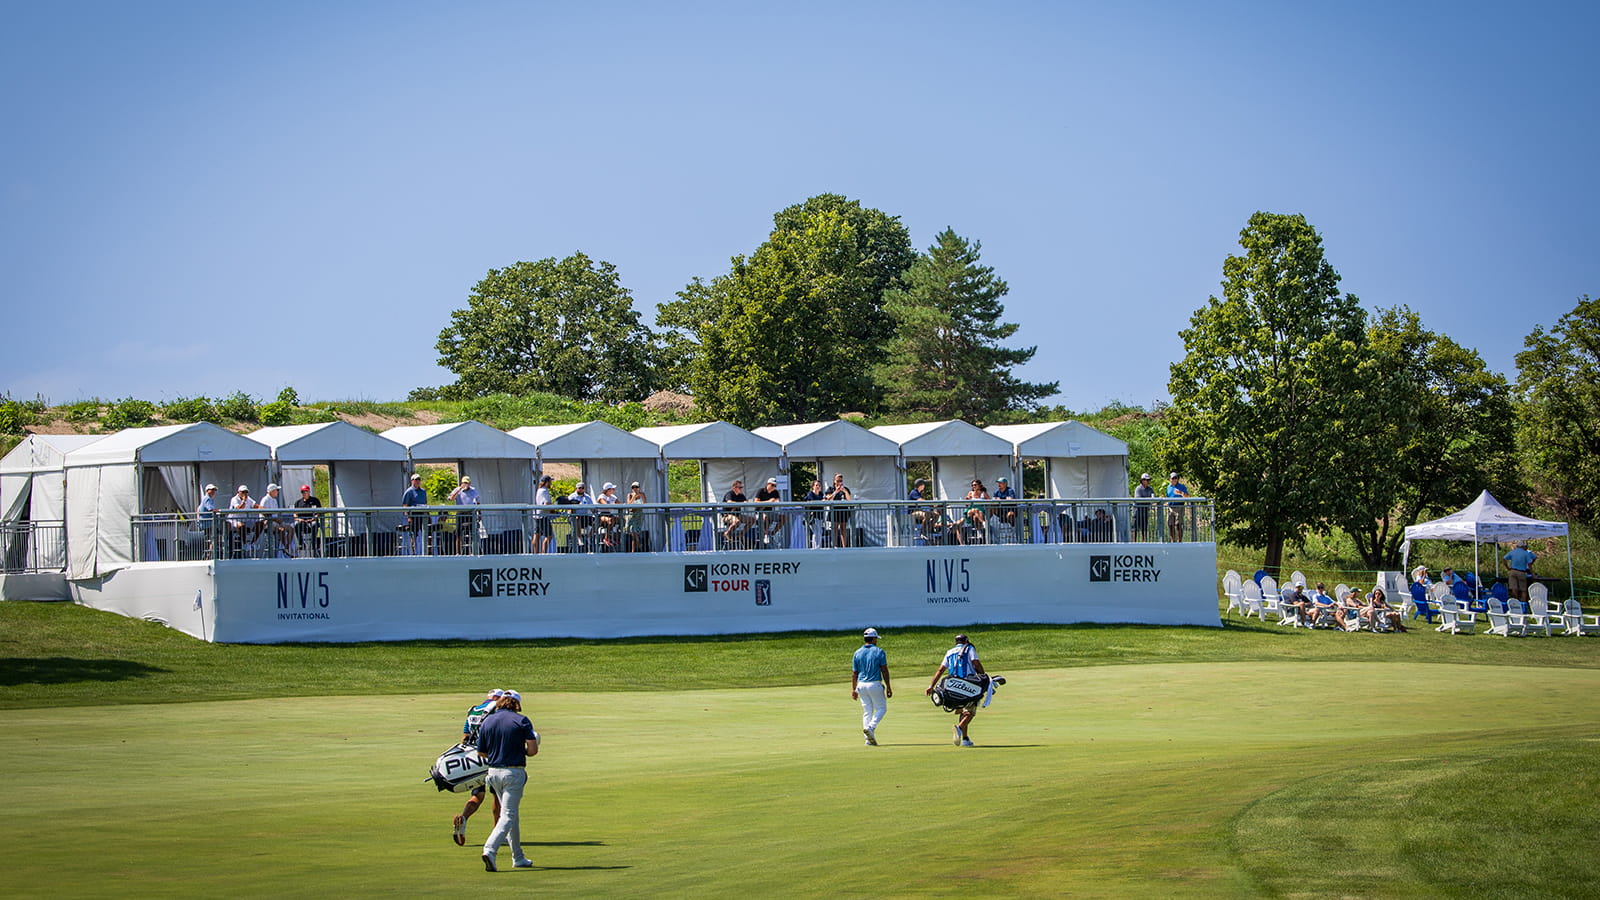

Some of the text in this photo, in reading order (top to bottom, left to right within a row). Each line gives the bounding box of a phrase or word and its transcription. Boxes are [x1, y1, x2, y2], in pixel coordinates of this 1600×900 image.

[1114, 555, 1154, 568] KORN
[496, 567, 543, 581] KORN
[711, 562, 801, 576] KORN FERRY
[1114, 569, 1161, 582] FERRY
[496, 582, 551, 597] FERRY
[711, 579, 750, 592] TOUR
[926, 596, 971, 604] INVITATIONAL
[277, 612, 331, 620] INVITATIONAL
[445, 756, 489, 775] PIN
